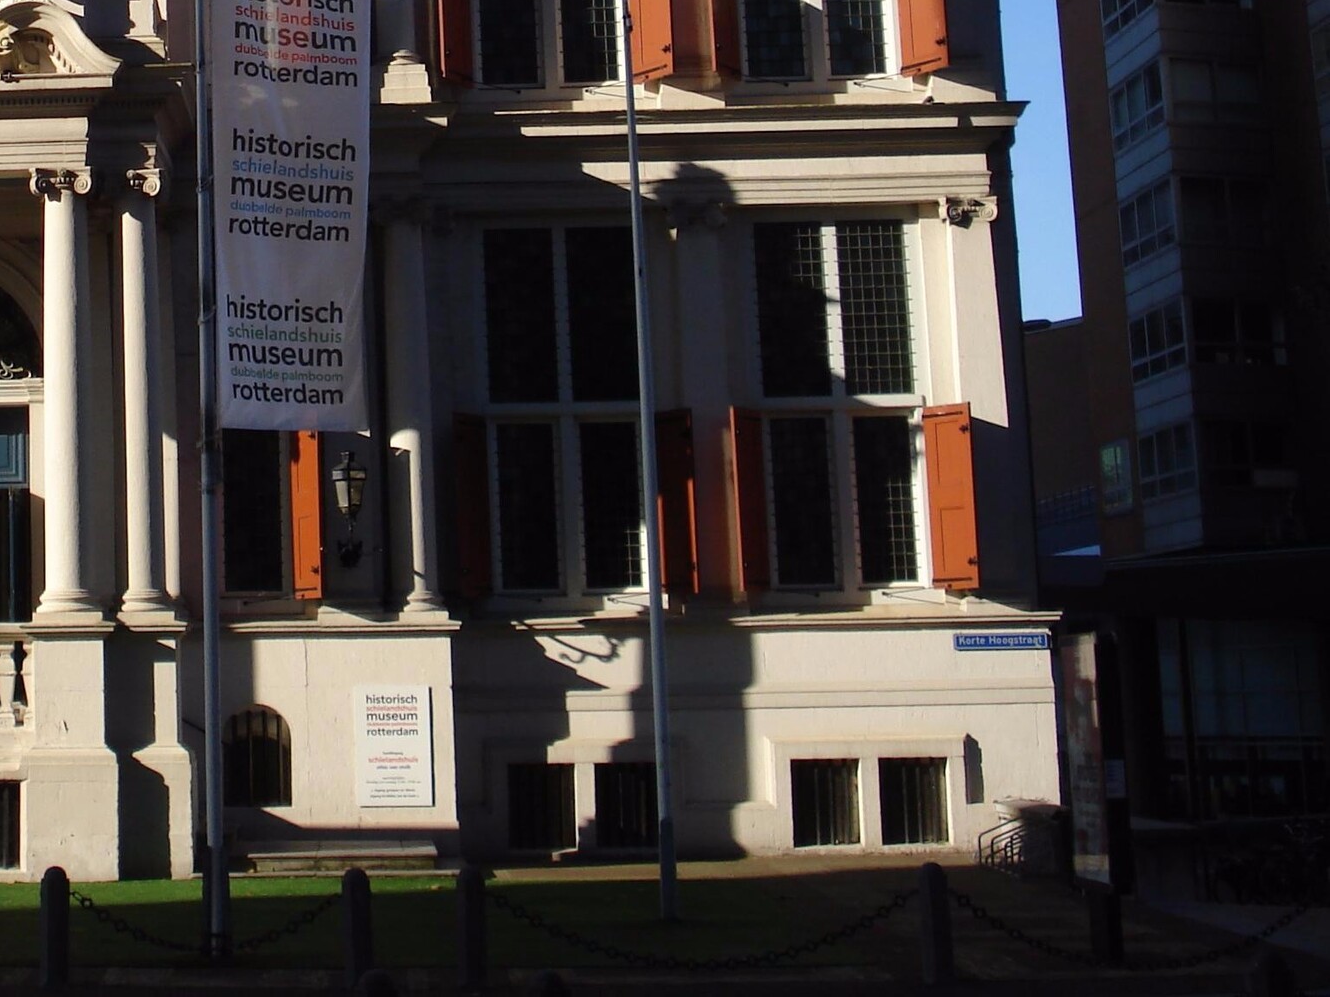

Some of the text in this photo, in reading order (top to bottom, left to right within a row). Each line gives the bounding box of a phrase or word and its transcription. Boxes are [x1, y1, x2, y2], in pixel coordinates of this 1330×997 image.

[235, 4, 355, 32] schielandshuis
[235, 20, 357, 52] museum
[291, 52, 358, 65] palmboom
[234, 59, 358, 87] rotterdam
[232, 128, 356, 162] historisch
[232, 157, 354, 181] schielandshuis
[231, 176, 353, 205] museum
[285, 207, 351, 219] palmboom
[229, 216, 349, 242] rotterdam
[226, 293, 343, 324] historisch
[227, 323, 342, 343] schielandshuis
[228, 343, 343, 367] museum
[281, 371, 343, 382] palmboom
[232, 382, 344, 405] rotterdam
[958, 635, 1043, 647] Korte Hoogstraat
[366, 694, 418, 704] historisch
[366, 713, 418, 721] museum
[366, 727, 419, 736] rotterdam
